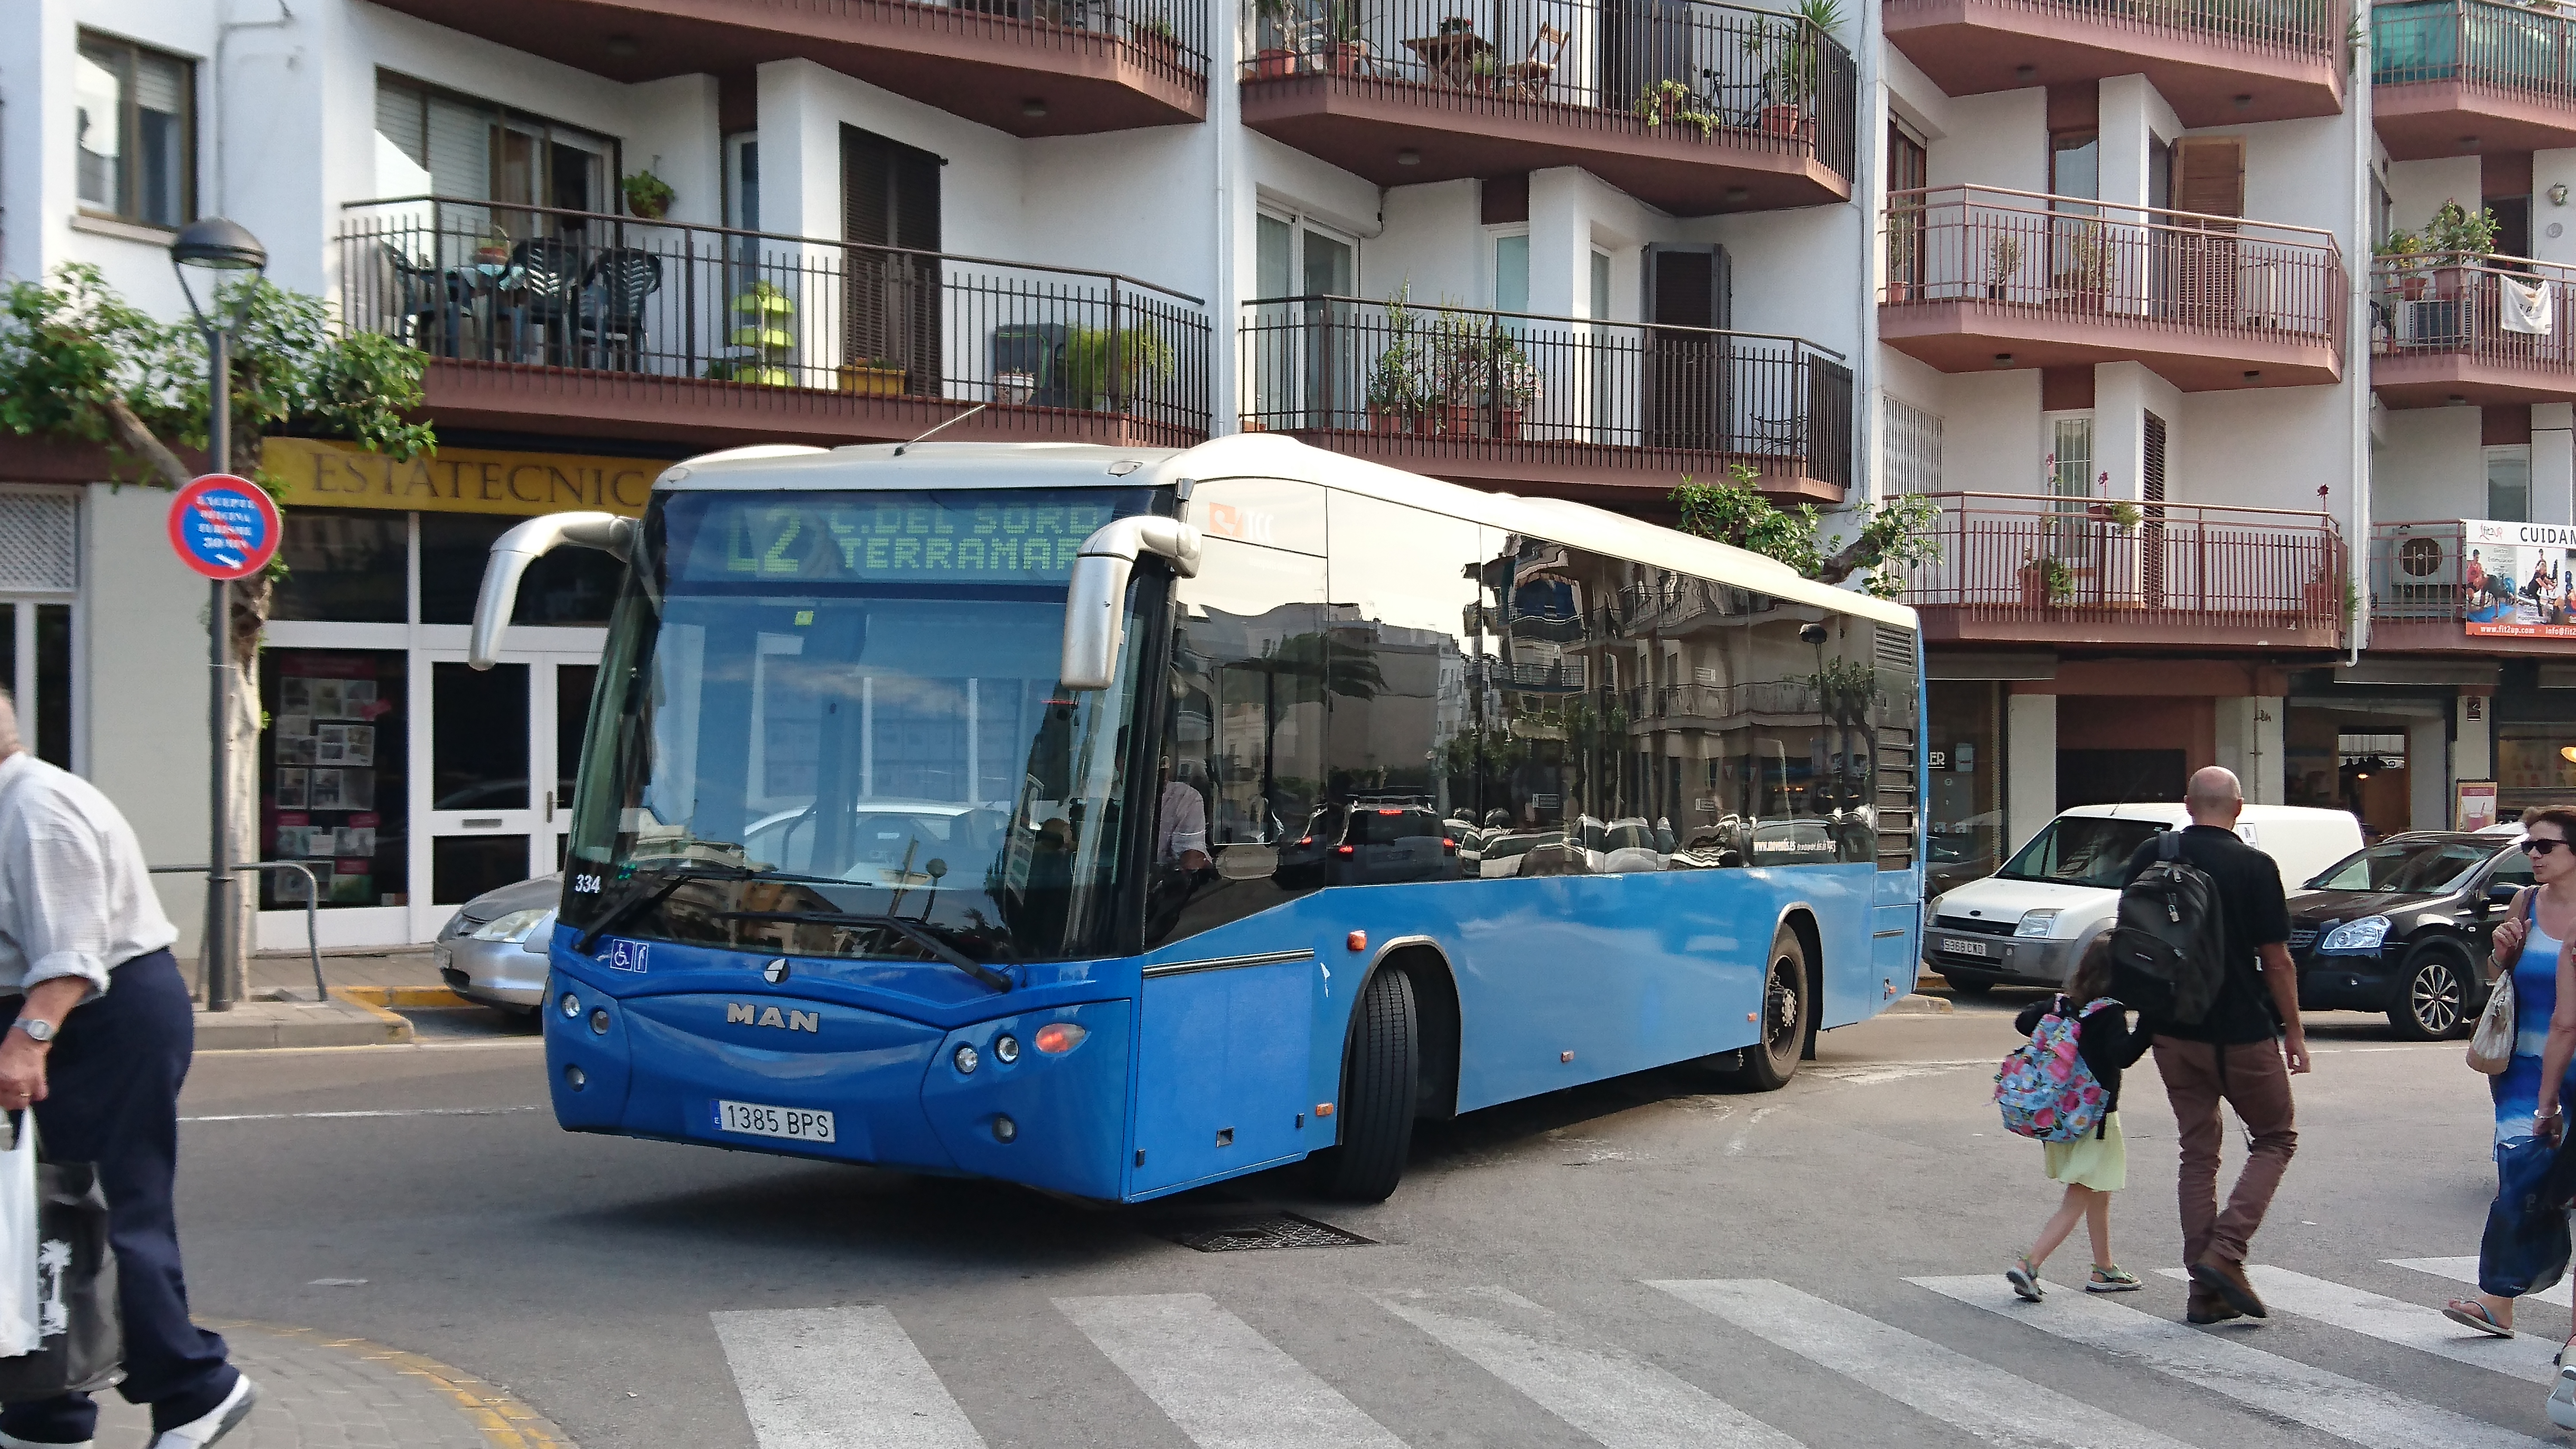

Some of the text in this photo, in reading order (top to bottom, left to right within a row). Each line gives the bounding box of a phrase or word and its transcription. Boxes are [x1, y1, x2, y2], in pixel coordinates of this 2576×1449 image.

[309, 452, 644, 508] ESTATECNIC
[727, 505, 801, 573] L2
[839, 538, 1082, 570] TERRAMAR
[2480, 625, 2535, 635] www.fit2up.com
[1928, 752, 1945, 765] ER
[575, 874, 601, 893] 334
[728, 1003, 818, 1033] MAN
[728, 1105, 828, 1137] 1385 BPS
